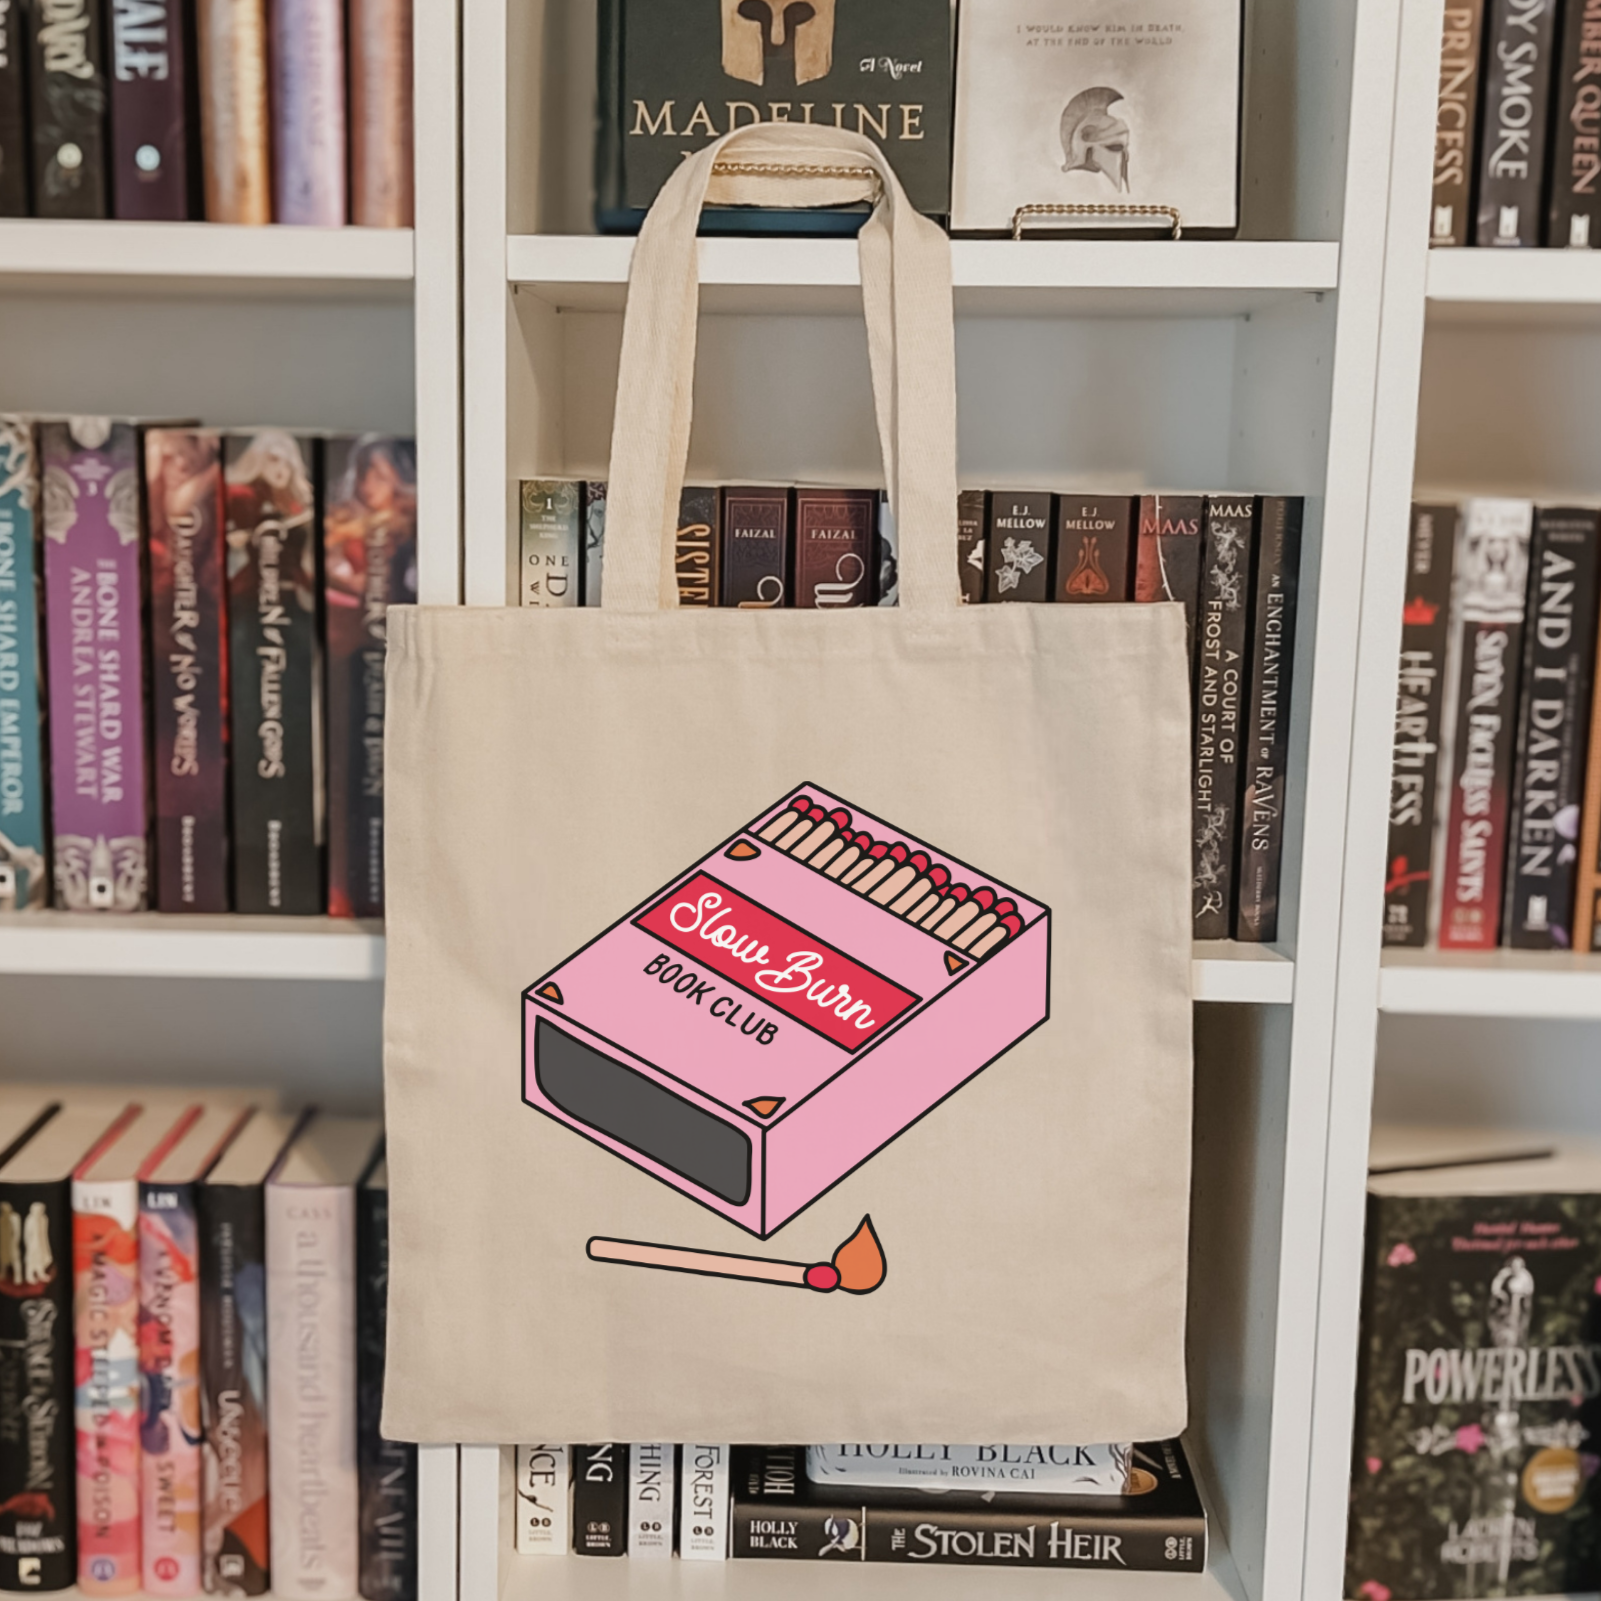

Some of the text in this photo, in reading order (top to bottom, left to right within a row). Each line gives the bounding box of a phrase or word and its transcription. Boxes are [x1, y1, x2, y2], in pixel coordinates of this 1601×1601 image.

[878, 56, 923, 80] Novel
[1432, 8, 1473, 185] PRINCESS
[1488, 40, 1538, 180] SMOKE
[1570, 84, 1601, 194] QUEEN
[735, 529, 776, 539] FAIZAL
[811, 529, 857, 540] FAIZAL
[997, 518, 1046, 529] MELLOW
[1065, 520, 1116, 530] MELLOW
[1141, 518, 1198, 536] MAAS
[1209, 504, 1253, 518] MAAS
[528, 553, 569, 567] ONE
[675, 523, 711, 607] SISTE
[96, 572, 120, 642] BONE
[1537, 549, 1577, 648] AND
[70, 566, 98, 798] ANDREA STEWART
[97, 648, 123, 740] SHARD
[169, 654, 202, 691] NO
[1258, 592, 1284, 746] ENCHANTMENT
[1534, 666, 1568, 682] I
[1197, 600, 1222, 812] FROST AND STARLIGHT
[1219, 650, 1240, 764] A COURT OF
[1390, 650, 1437, 827] HEARTLESS
[1, 697, 24, 815] EMPEROR
[101, 744, 124, 804] WAR
[1519, 699, 1566, 877] DARKEN
[1251, 766, 1279, 851] RAVENS
[670, 892, 876, 1029] Slow Burn
[643, 953, 779, 1045] BOOK CLUB
[297, 1258, 329, 1402] thousand
[299, 1410, 330, 1570] heartbeats
[636, 1444, 662, 1503] HING
[690, 1444, 720, 1520] FOREST
[763, 1446, 795, 1494] HOLL
[952, 1465, 1006, 1479] ROVINA
[1010, 1468, 1036, 1480] CAI
[976, 1444, 1098, 1467] BLACK
[157, 1460, 175, 1533] SWEET
[750, 1519, 799, 1535] HOLLY
[750, 1535, 799, 1549] BLACK
[891, 1527, 906, 1551] THE
[907, 1522, 1036, 1560] STOLEN
[1048, 1521, 1128, 1566] HEIR
